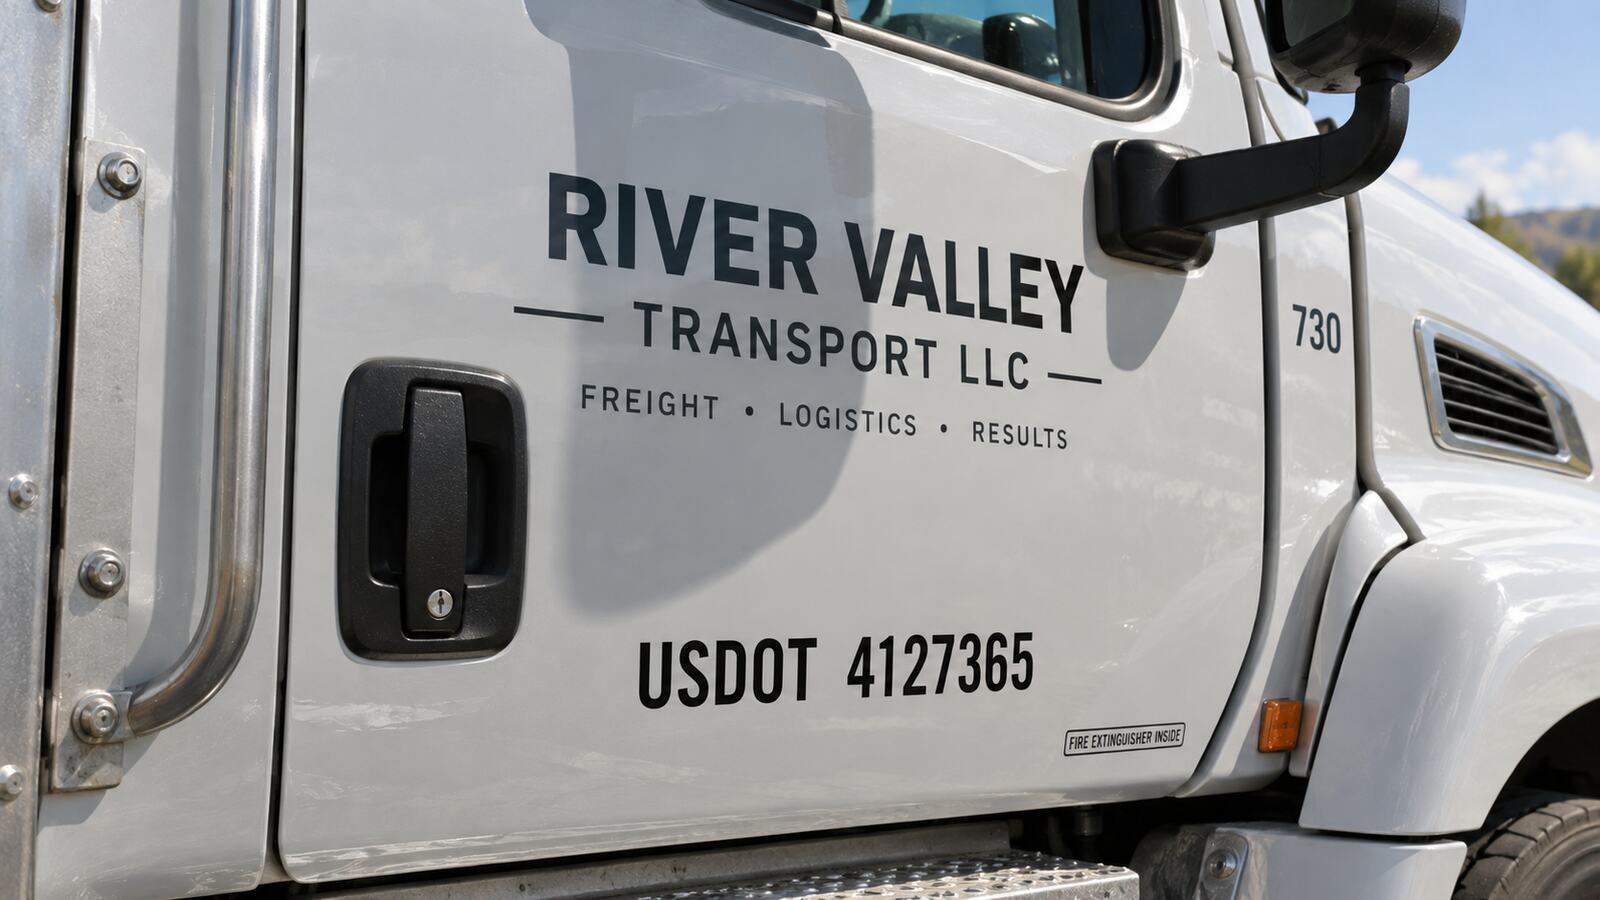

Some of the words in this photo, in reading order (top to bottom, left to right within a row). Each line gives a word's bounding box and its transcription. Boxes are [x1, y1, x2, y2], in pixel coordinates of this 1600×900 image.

[548, 172, 818, 296] RIVER
[844, 220, 1085, 334] VALLEY
[632, 300, 938, 380] TRANSPORT
[960, 344, 1029, 390] LLC
[1292, 303, 1341, 354] 730
[581, 383, 719, 420] FREIGHT
[779, 402, 917, 437] LOGISTICS
[971, 420, 1068, 450] RESULTS
[638, 637, 818, 710] USDOT
[847, 631, 1034, 699] 4127365
[1068, 735, 1090, 750] FIRE
[1091, 730, 1153, 749] EXTINGUISHER
[1154, 728, 1182, 744] INSIDE
